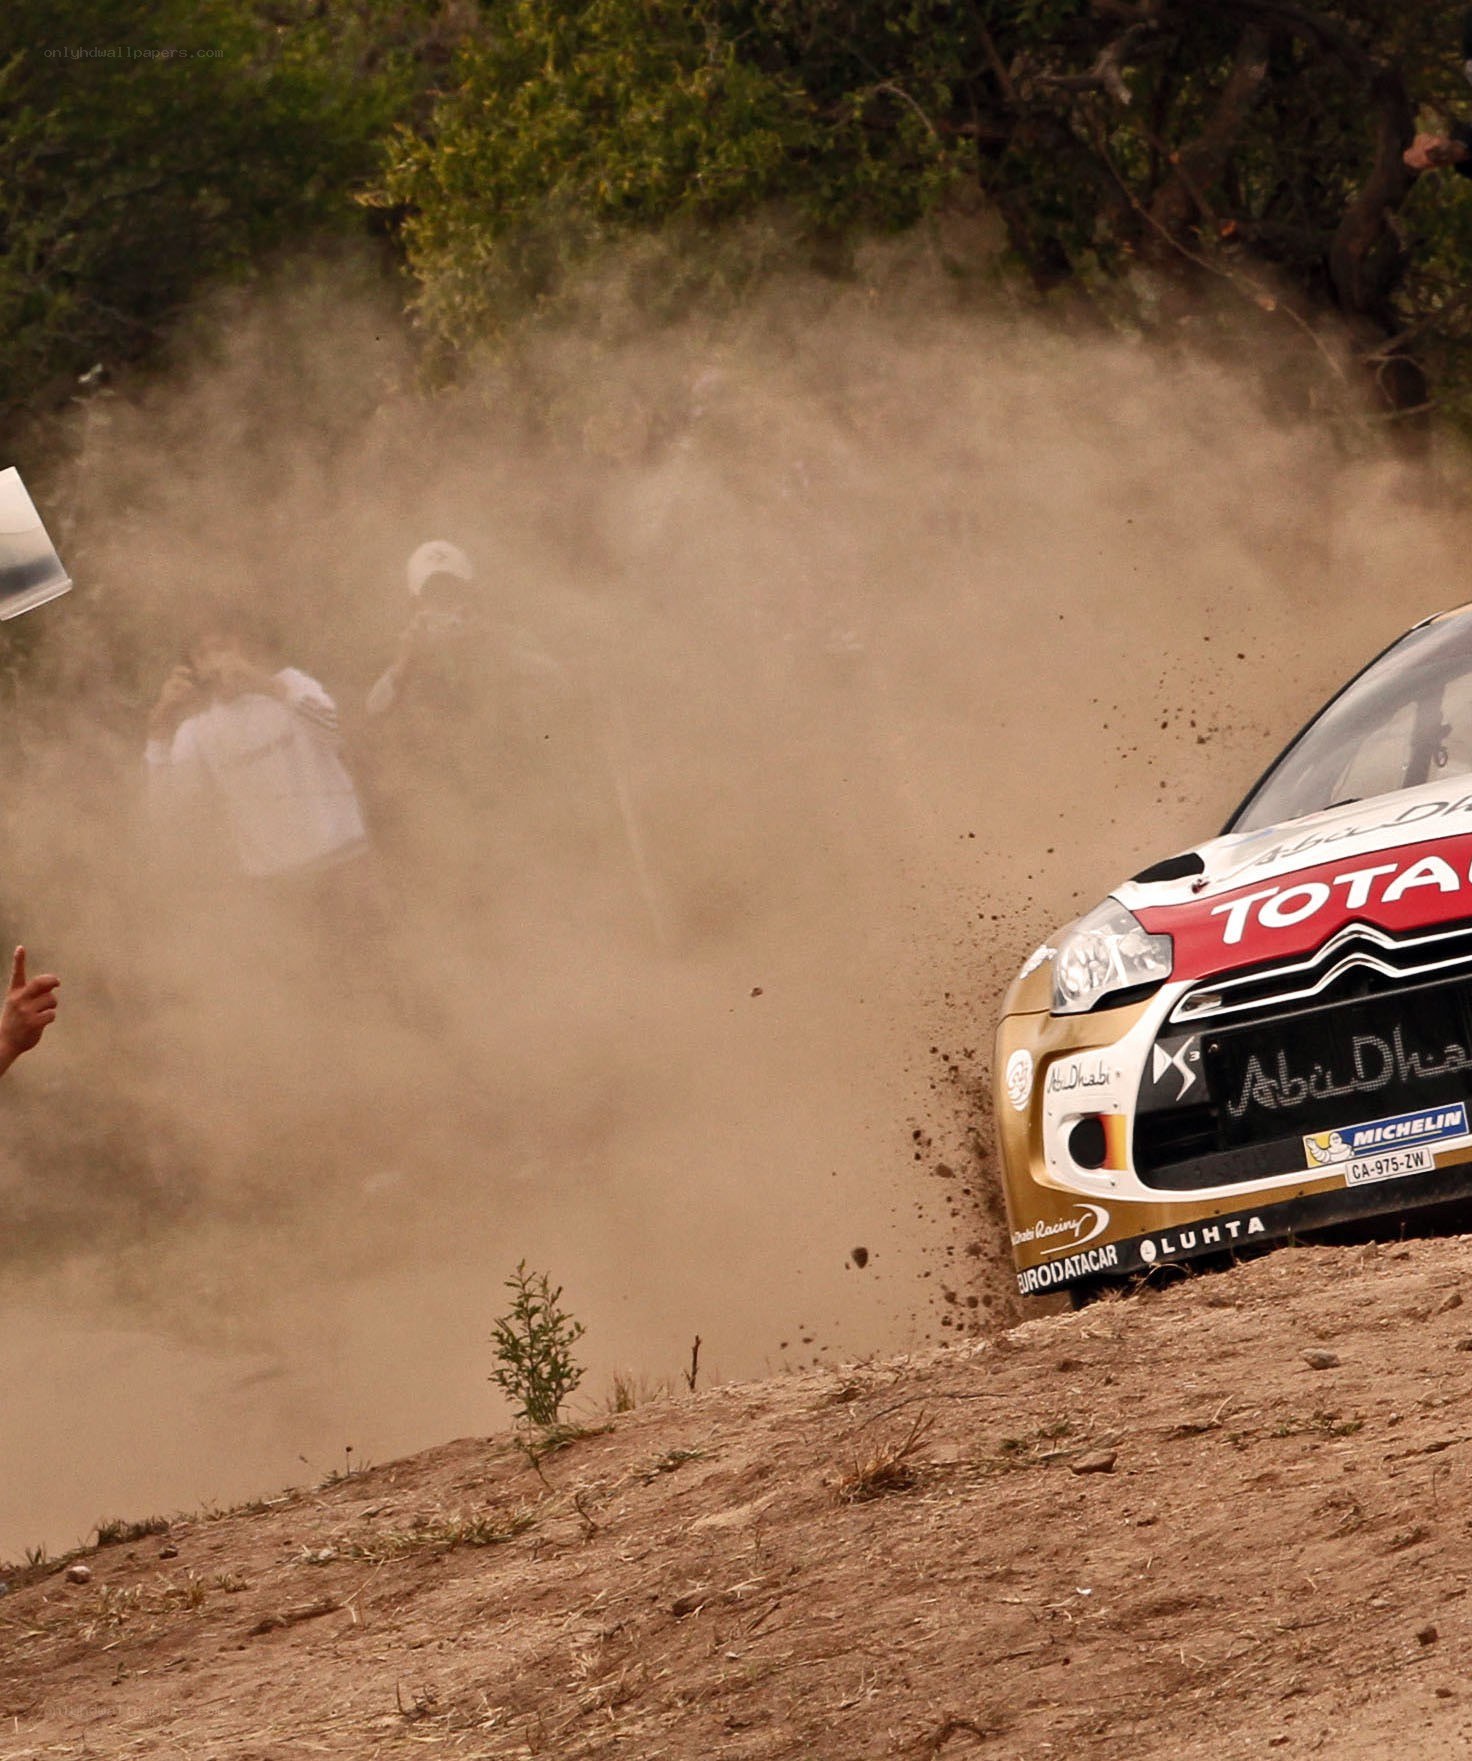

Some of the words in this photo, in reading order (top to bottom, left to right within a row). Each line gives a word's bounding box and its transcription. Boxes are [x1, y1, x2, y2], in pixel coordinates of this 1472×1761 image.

[1353, 1110, 1462, 1147] MICHELIN
[1352, 1151, 1425, 1180] CA-975-ZW
[1035, 1212, 1093, 1239] Racing
[1160, 1216, 1266, 1254] LUHTA
